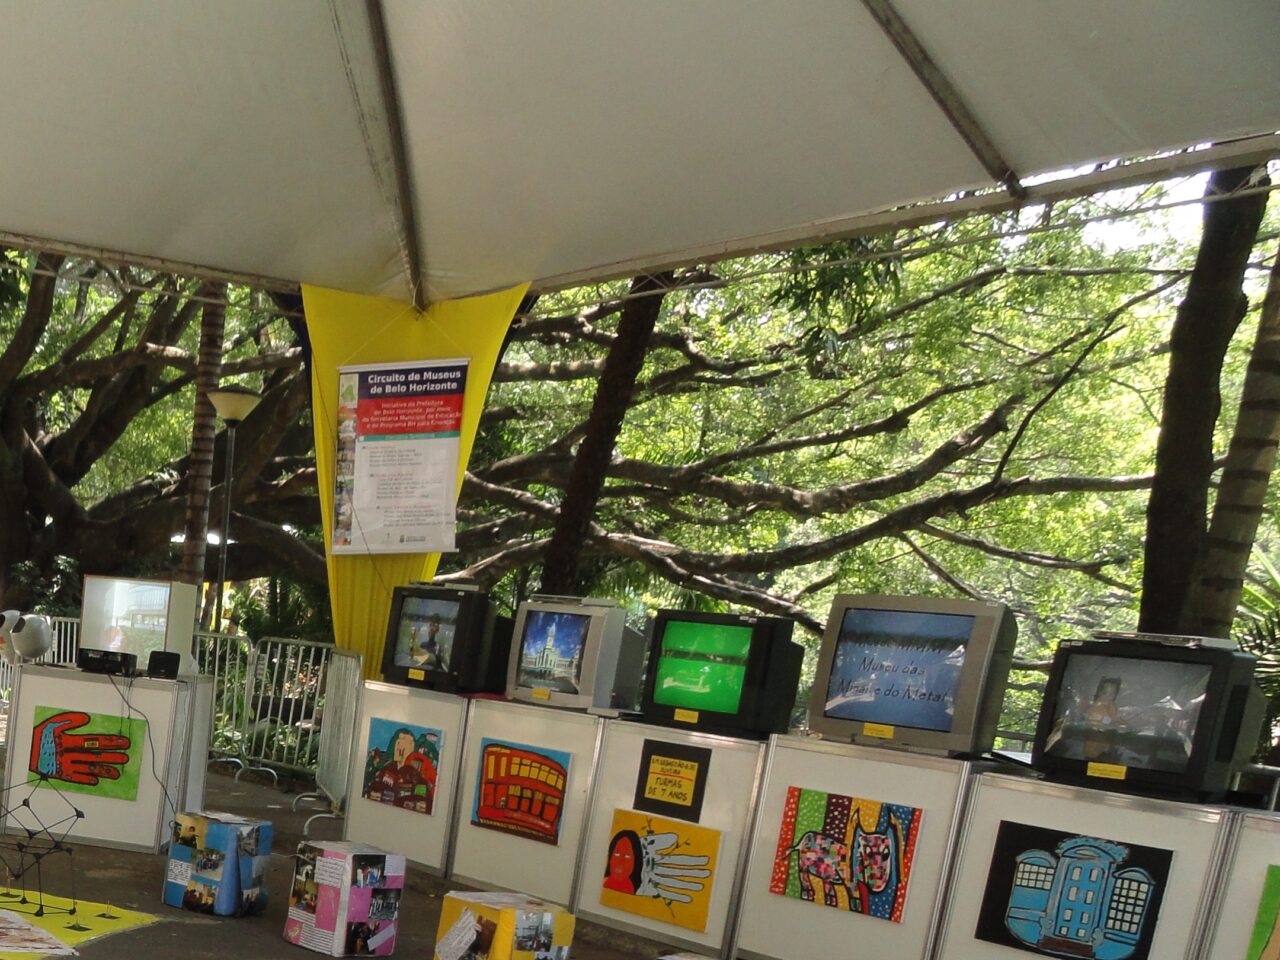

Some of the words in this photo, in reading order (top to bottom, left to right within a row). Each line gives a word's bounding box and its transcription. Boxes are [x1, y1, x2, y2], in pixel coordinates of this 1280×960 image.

[368, 373, 406, 384] Circuito
[407, 372, 421, 381] de
[423, 370, 461, 380] Museus
[370, 385, 383, 394] de
[385, 384, 406, 393] Belo
[409, 382, 458, 392] Horizonte
[858, 656, 899, 673] Museu
[901, 660, 926, 676] das
[883, 683, 899, 697] do
[902, 685, 949, 702] Metal
[655, 777, 682, 789] TURMAS
[648, 786, 657, 796] DE
[661, 788, 666, 797] 7
[668, 790, 688, 801] ANOS
